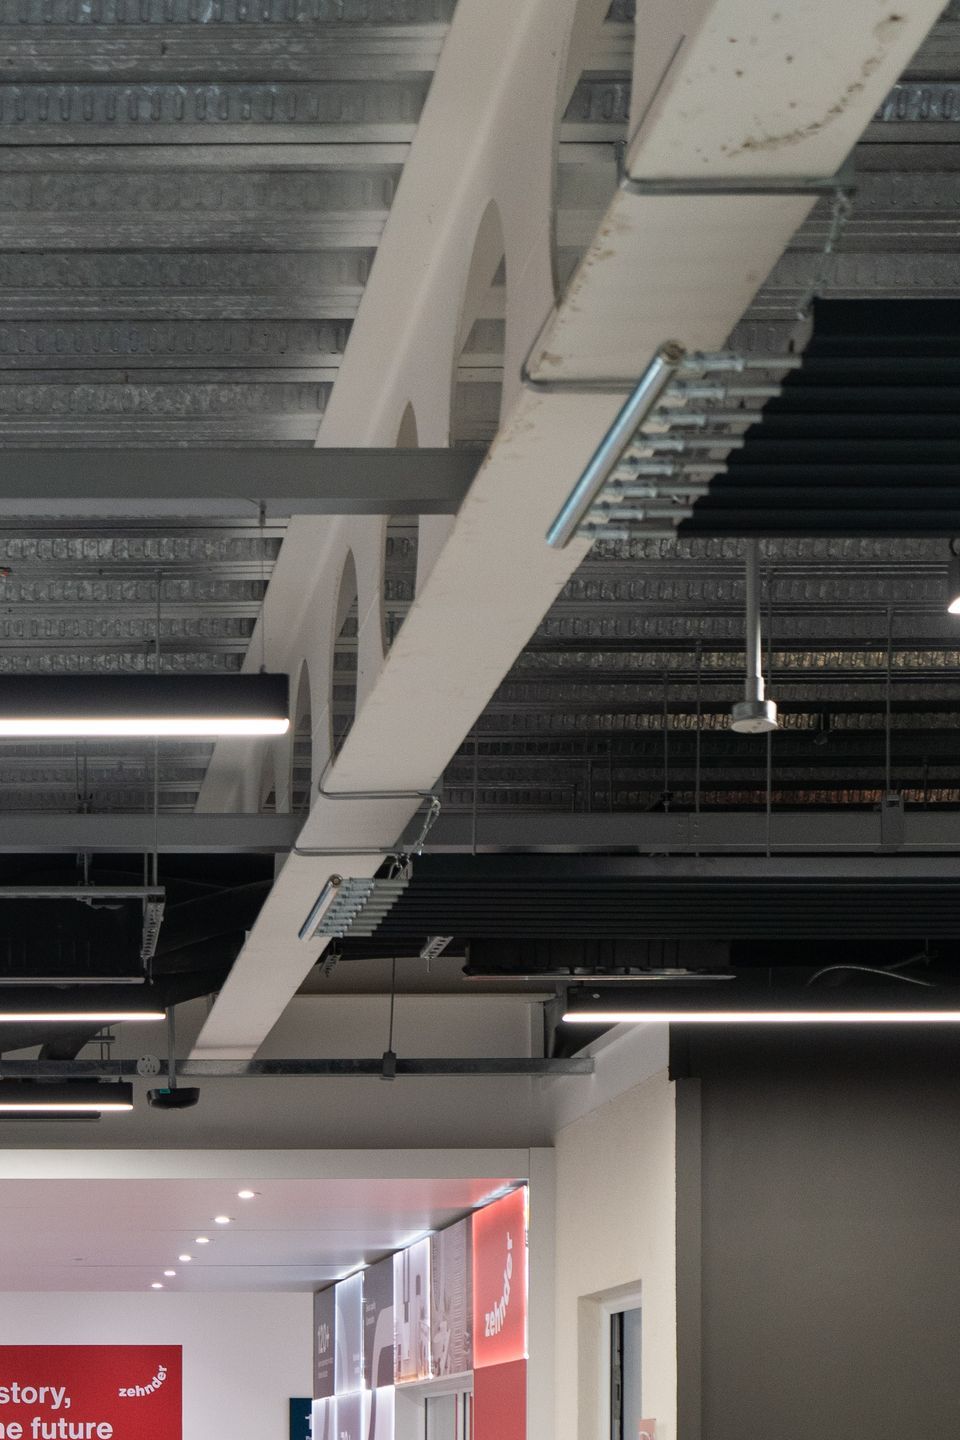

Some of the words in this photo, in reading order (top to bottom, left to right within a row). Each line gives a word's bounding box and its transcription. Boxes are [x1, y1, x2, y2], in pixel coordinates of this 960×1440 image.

[485, 1231, 513, 1337] zehnder
[317, 1322, 330, 1354] 120+
[118, 1364, 168, 1398] zehnder
[30, 1416, 114, 1440] future
